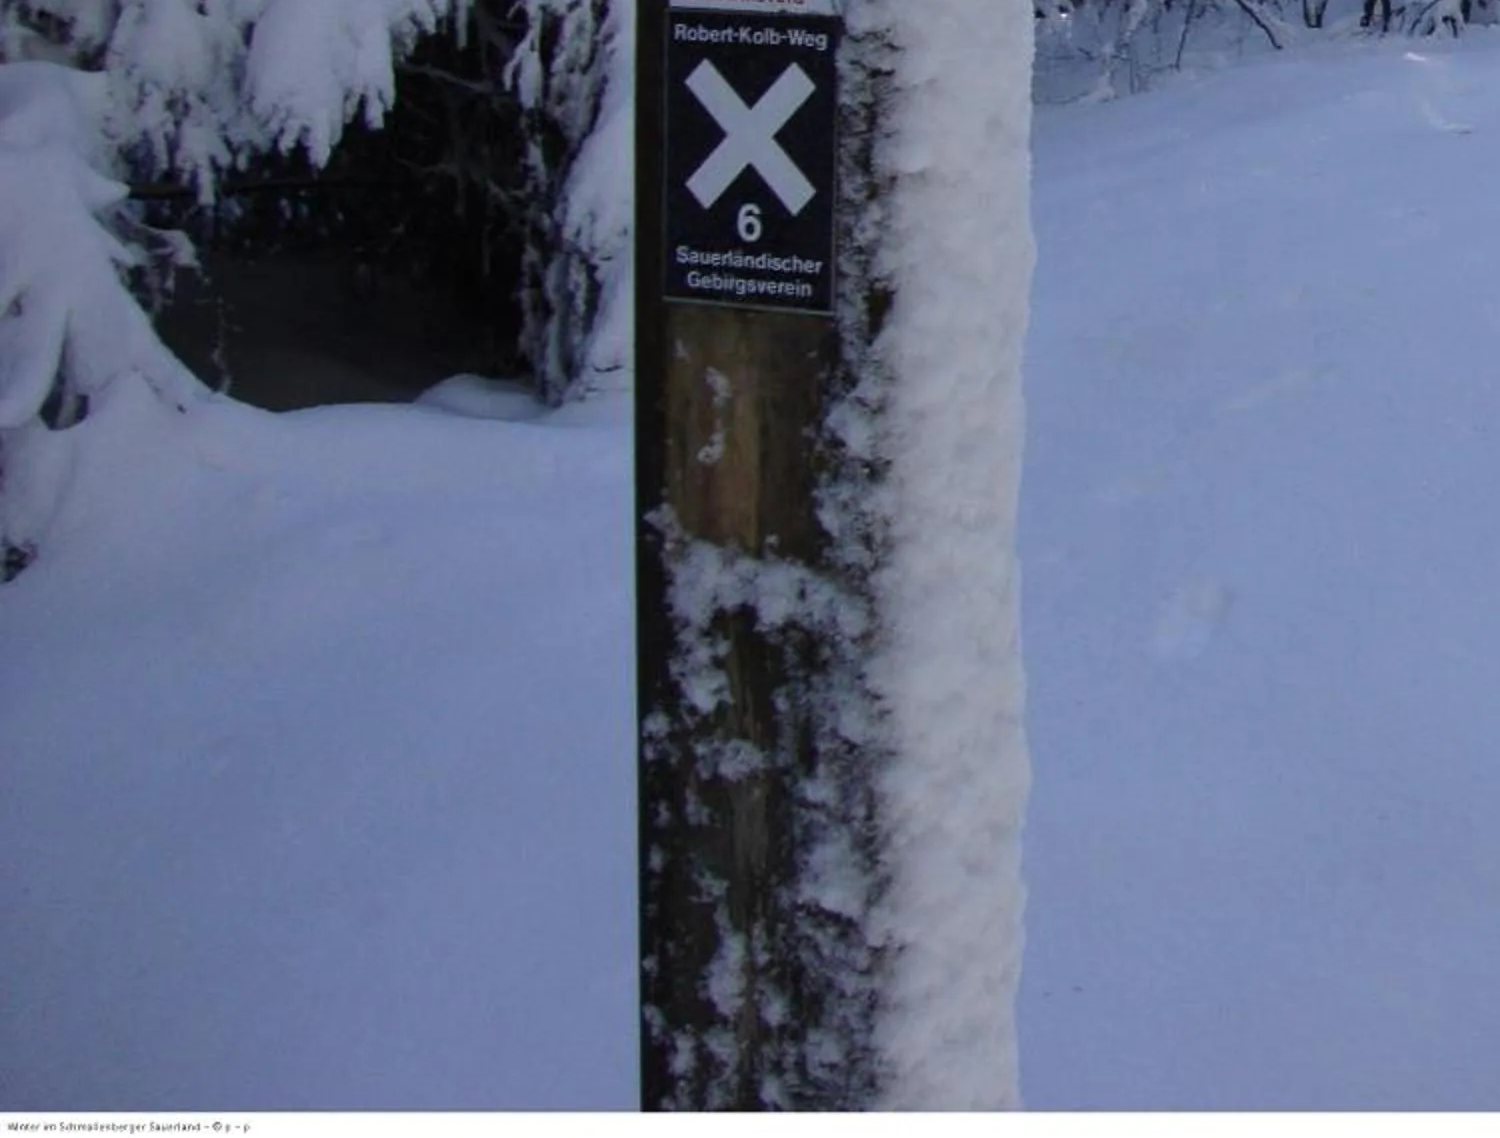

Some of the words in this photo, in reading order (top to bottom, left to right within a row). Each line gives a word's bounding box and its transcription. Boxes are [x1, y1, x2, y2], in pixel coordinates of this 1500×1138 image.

[674, 24, 827, 50] Robert-Kolb-Weg
[736, 202, 762, 243] 6
[674, 244, 823, 274] Sauerländischer
[686, 270, 813, 298] Gebirgsverein
